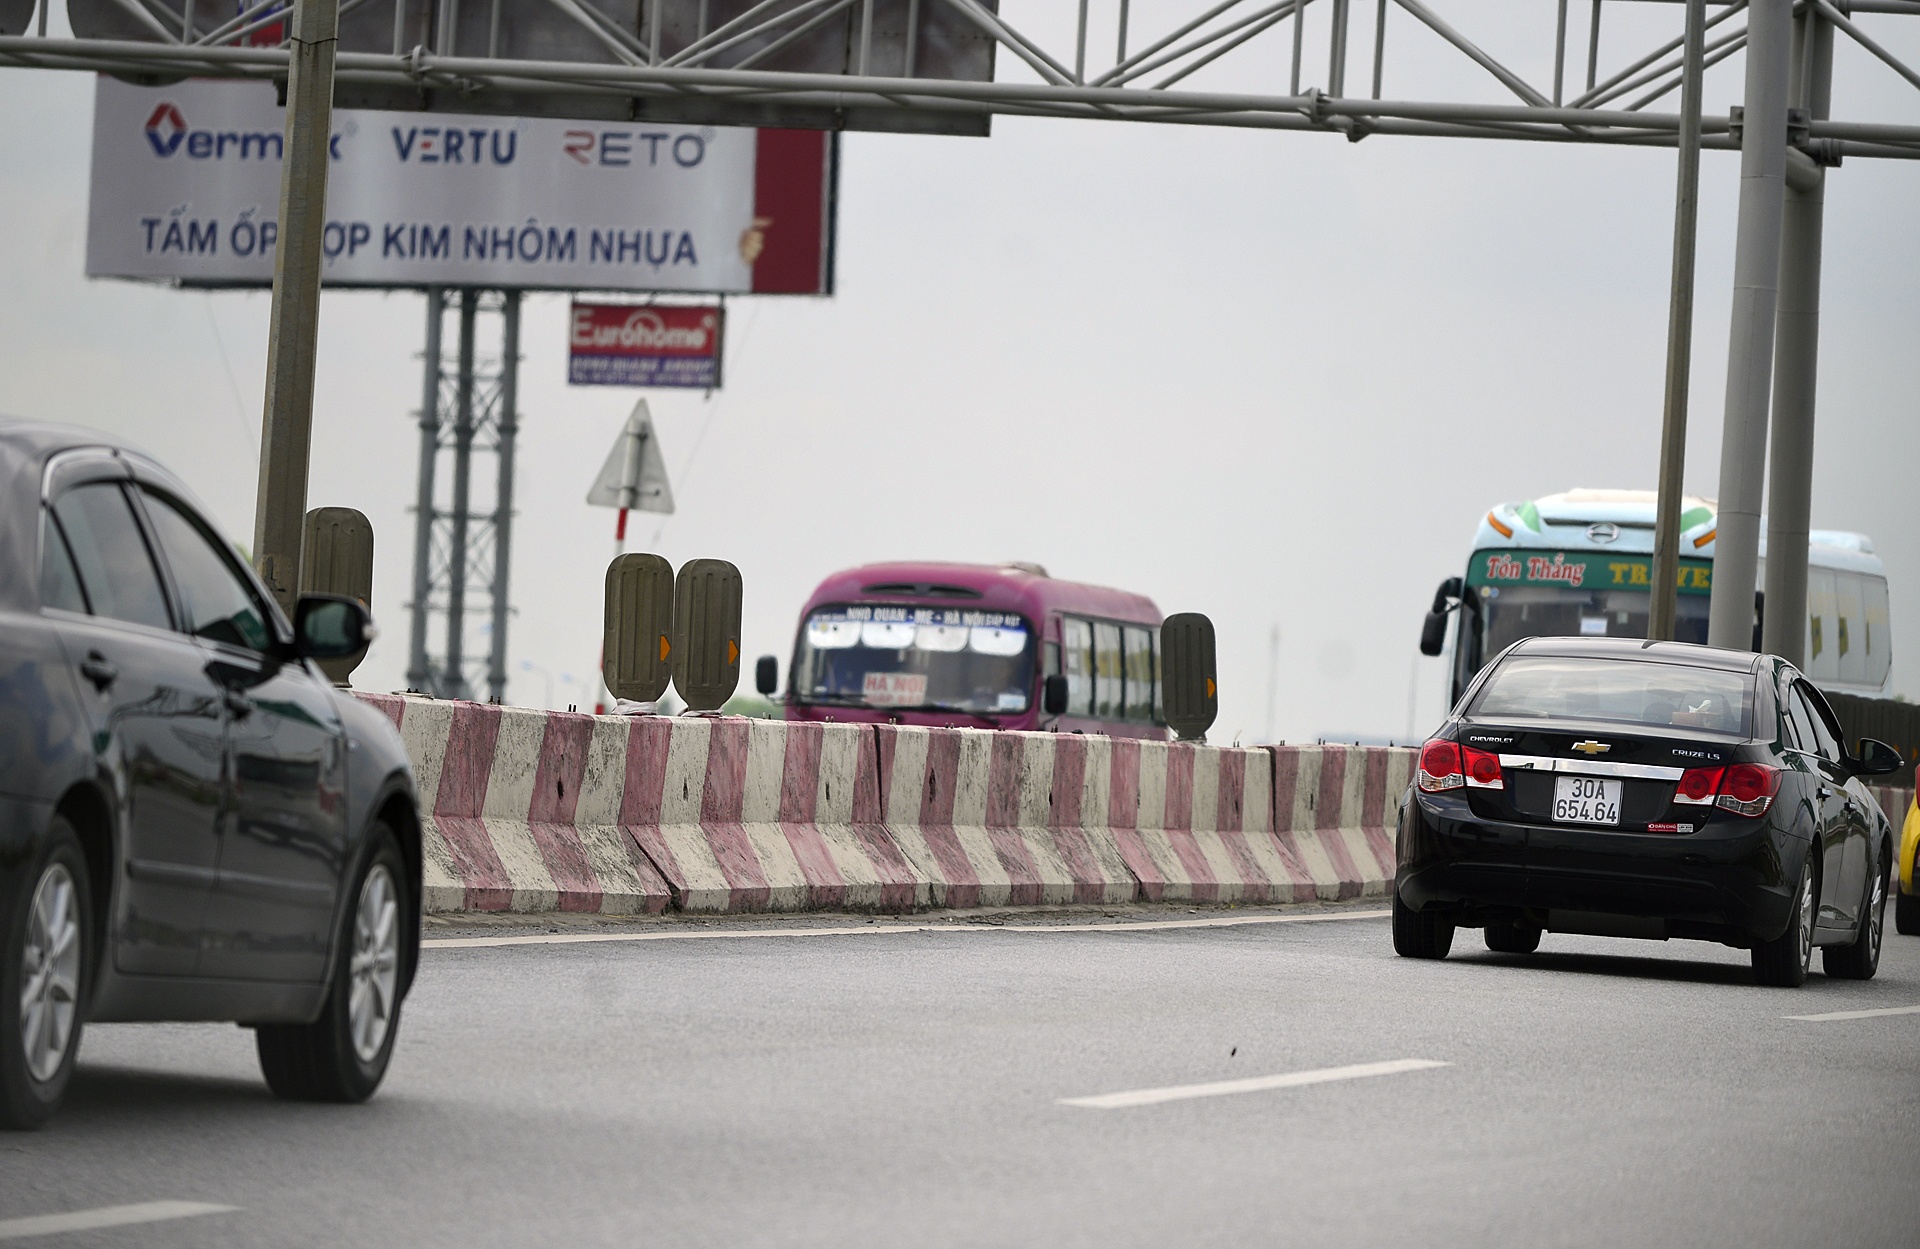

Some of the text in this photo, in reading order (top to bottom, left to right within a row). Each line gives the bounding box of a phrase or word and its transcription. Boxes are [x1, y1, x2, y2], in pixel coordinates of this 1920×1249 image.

[392, 126, 517, 166] VERTU
[563, 128, 707, 169] RETO
[141, 204, 698, 274] TẤM ỐP ỢP KIM NHÔM NHỰA
[1608, 562, 1714, 589] TRVE
[1470, 735, 1514, 744] CHEVROLET
[1672, 748, 1720, 760] CRUZE LS
[1571, 778, 1605, 800] 30A
[1556, 798, 1617, 822] 654.64
